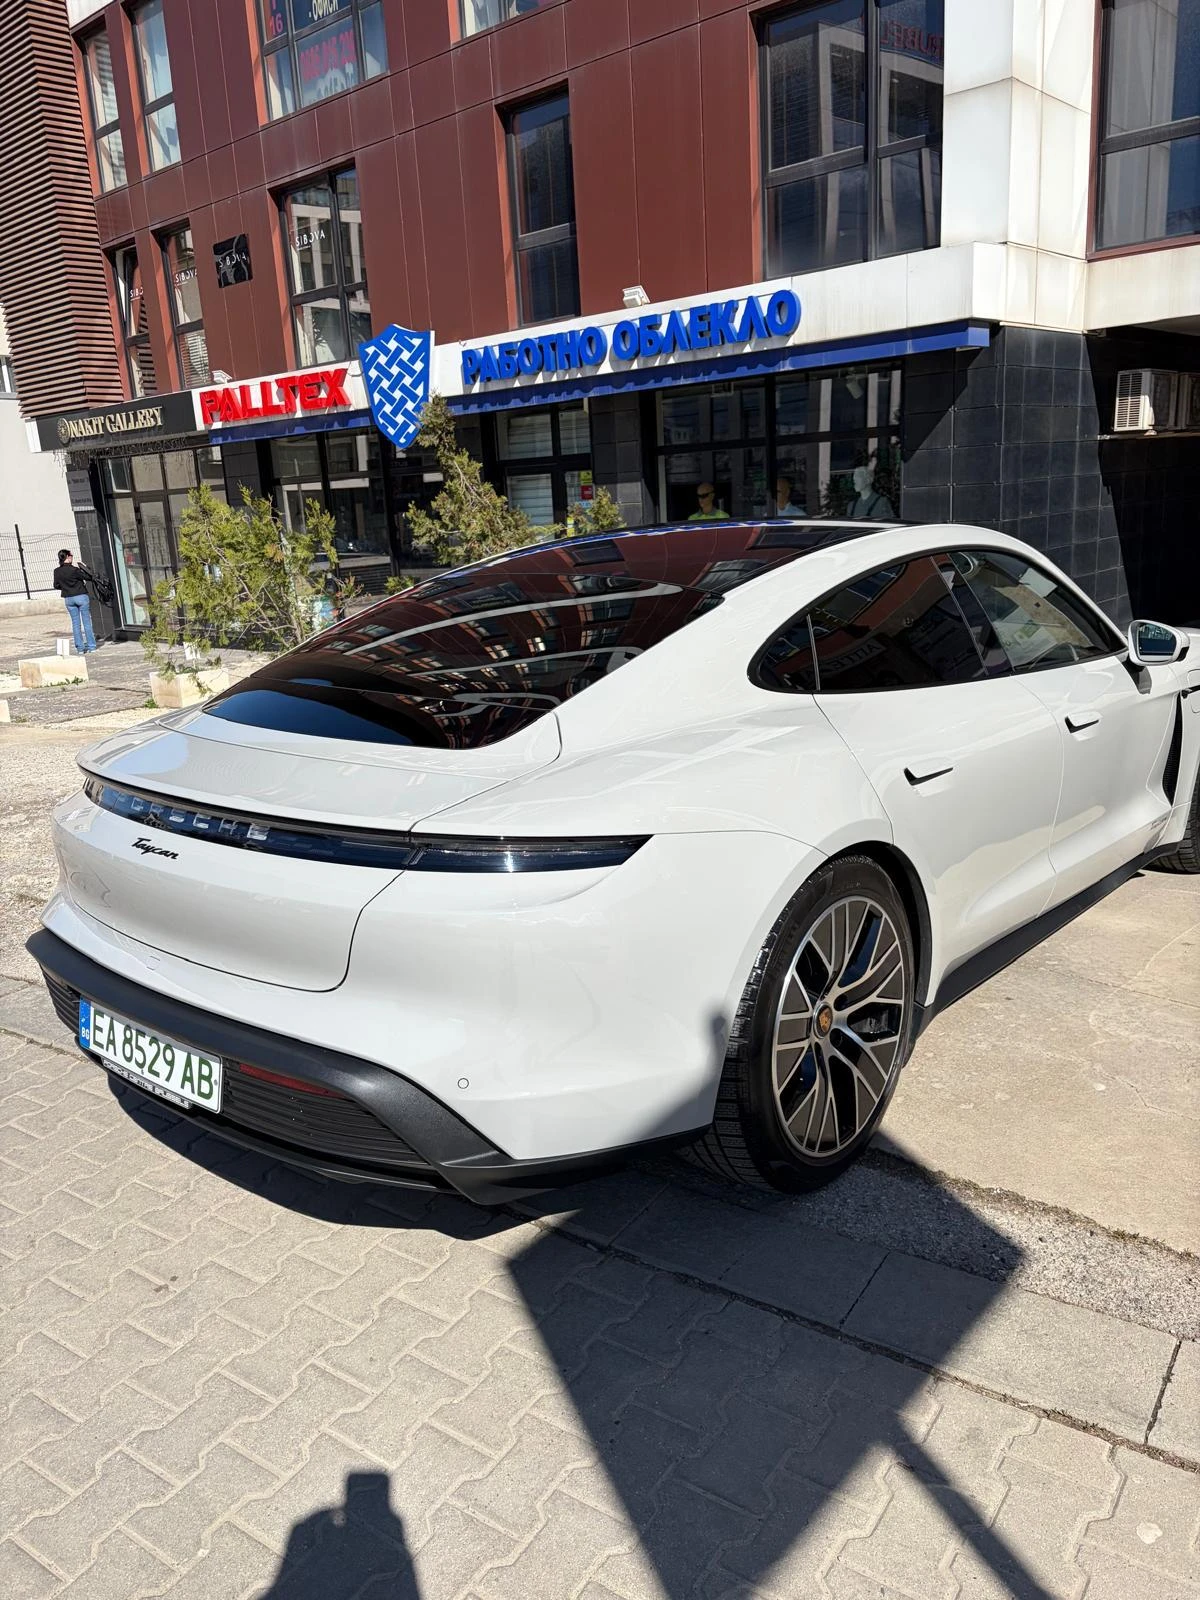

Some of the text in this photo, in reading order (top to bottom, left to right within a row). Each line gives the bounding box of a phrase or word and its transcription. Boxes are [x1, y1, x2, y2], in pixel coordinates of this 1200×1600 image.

[270, 12, 283, 35] 16
[218, 252, 247, 268] SBOVA
[461, 288, 802, 386] РАБОТНО ОБЛЕКЛО
[199, 368, 352, 425] PALLTEX
[69, 406, 164, 438] NAKIT GALLERY
[131, 837, 181, 860] Taycan
[81, 1027, 90, 1040] BG
[92, 1009, 118, 1057] EA
[122, 1024, 176, 1083] 8529
[180, 1052, 214, 1100] AB
